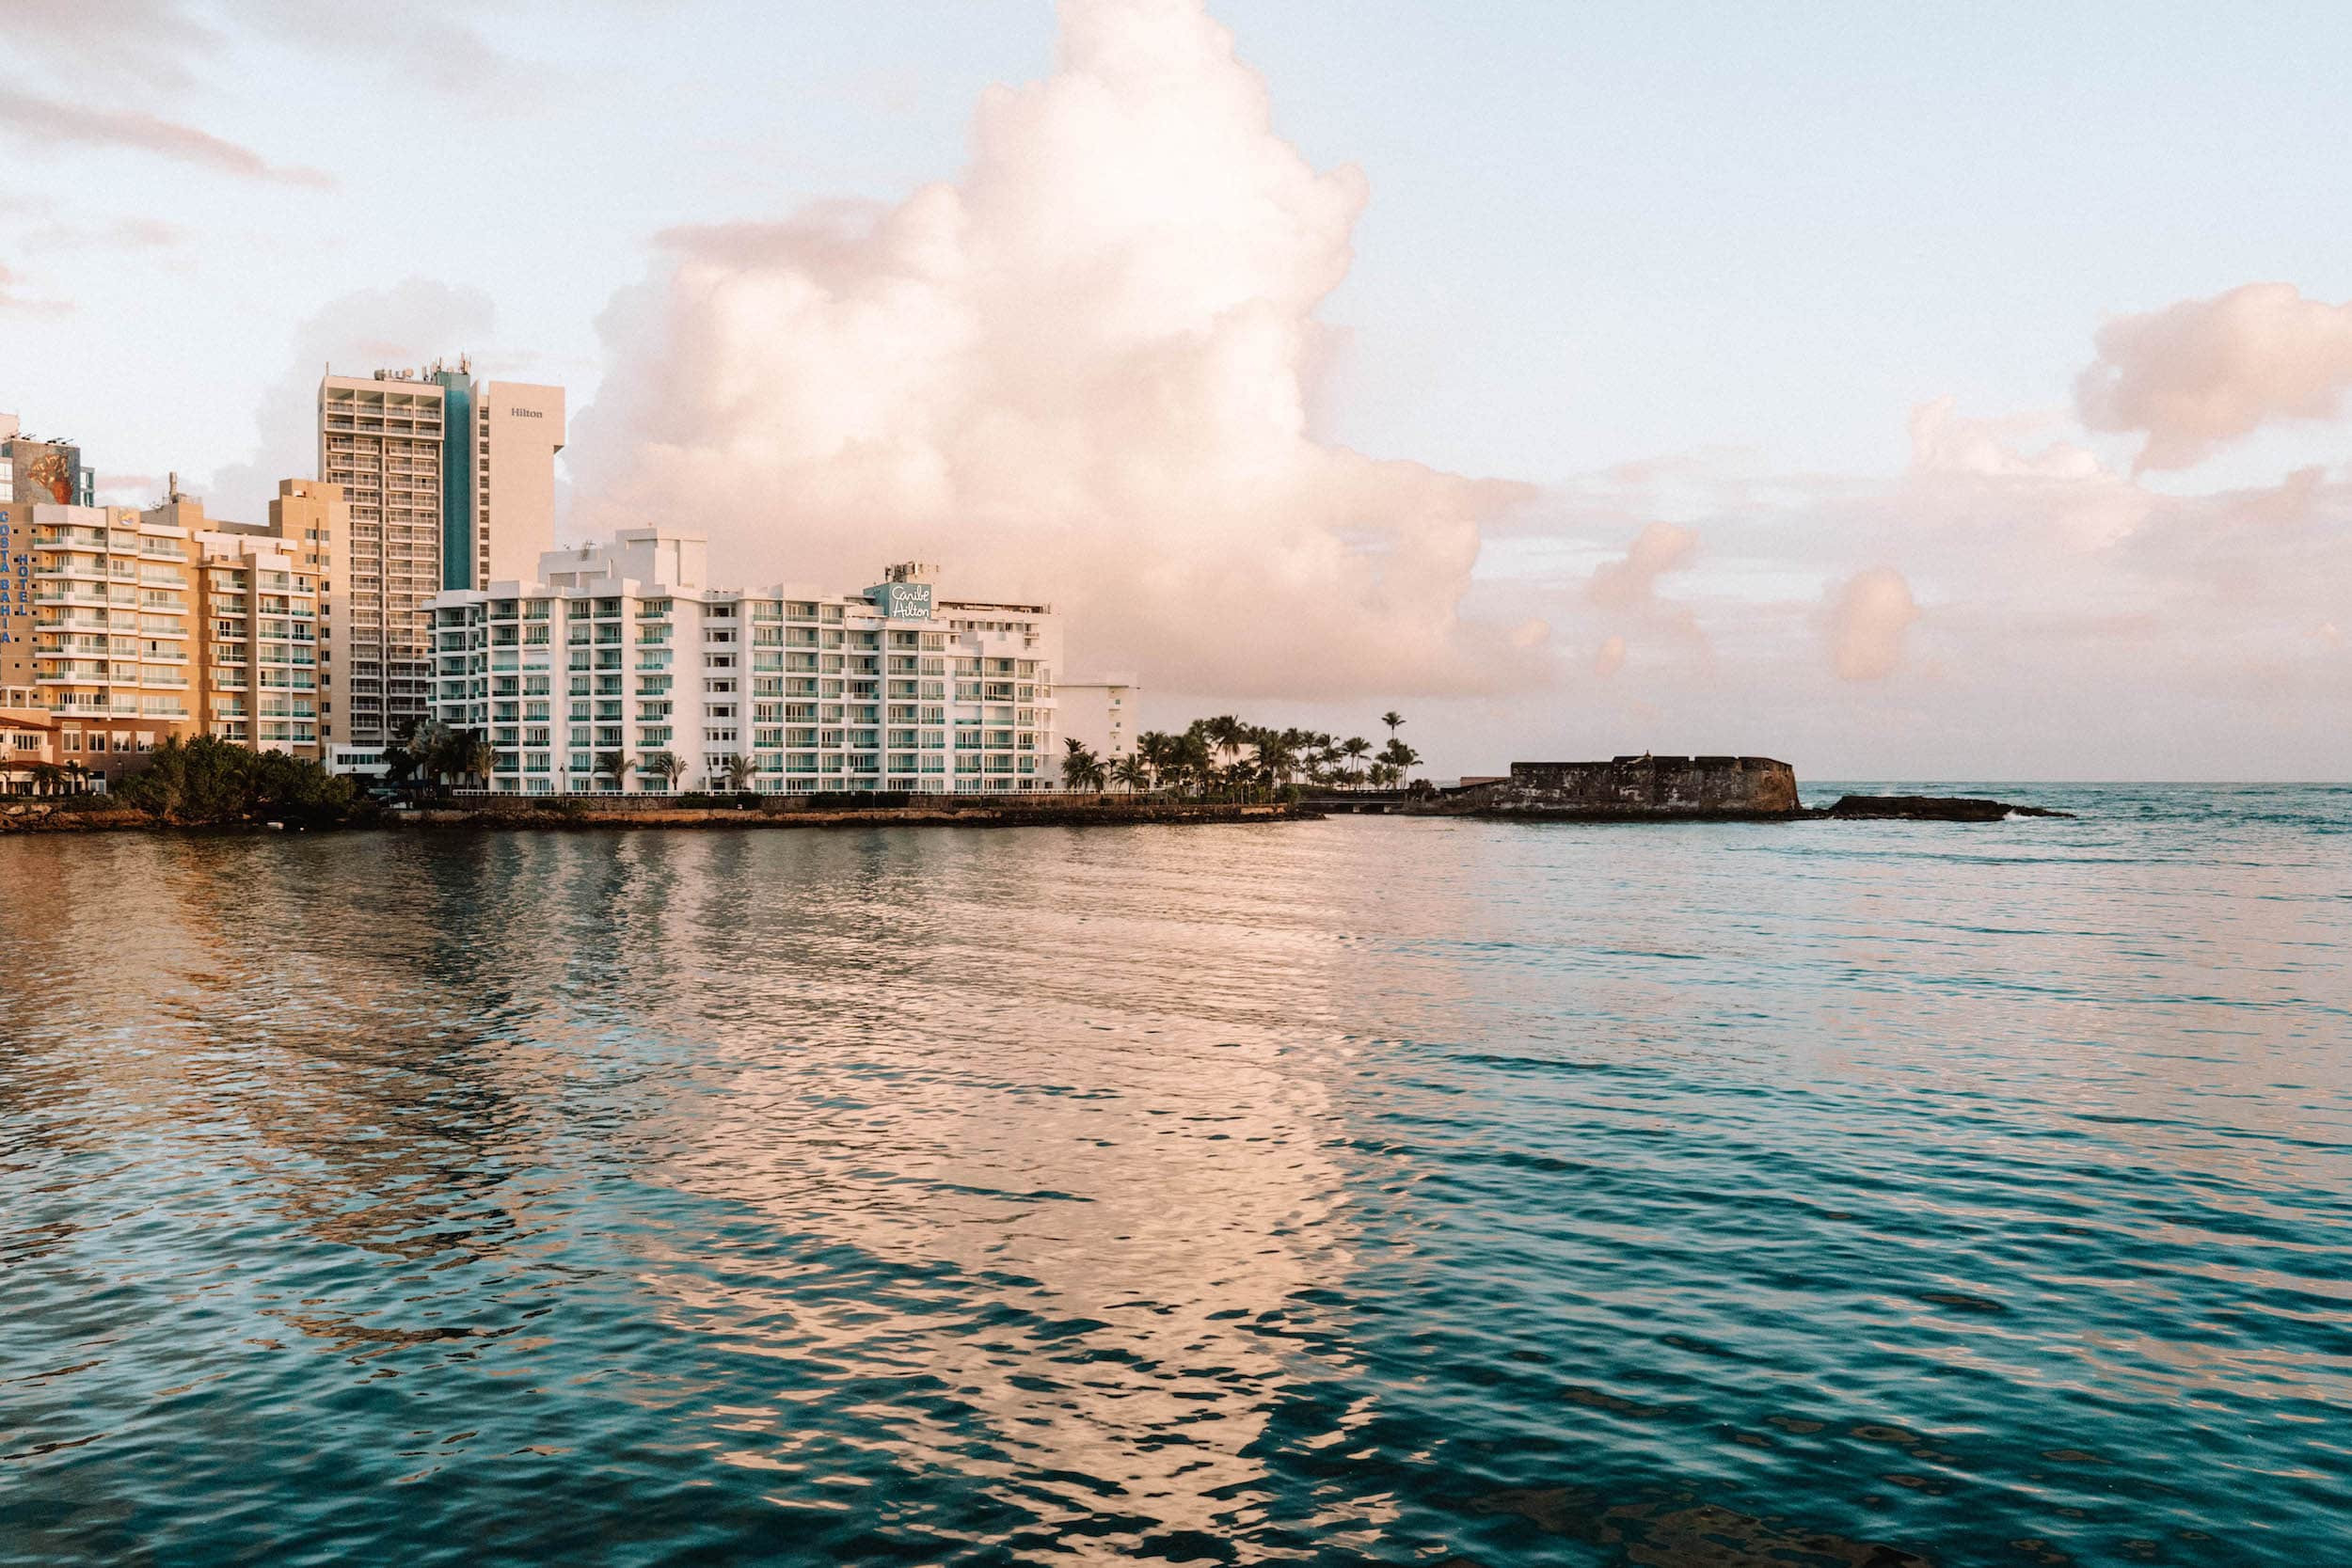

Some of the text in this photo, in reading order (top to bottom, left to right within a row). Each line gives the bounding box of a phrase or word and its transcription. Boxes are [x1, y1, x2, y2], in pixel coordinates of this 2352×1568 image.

[511, 407, 543, 419] Hilton
[0, 511, 11, 643] COSTA BAHIA
[18, 553, 29, 616] HOTEL
[891, 584, 930, 602] Caribe
[892, 599, 930, 618] Hilton
